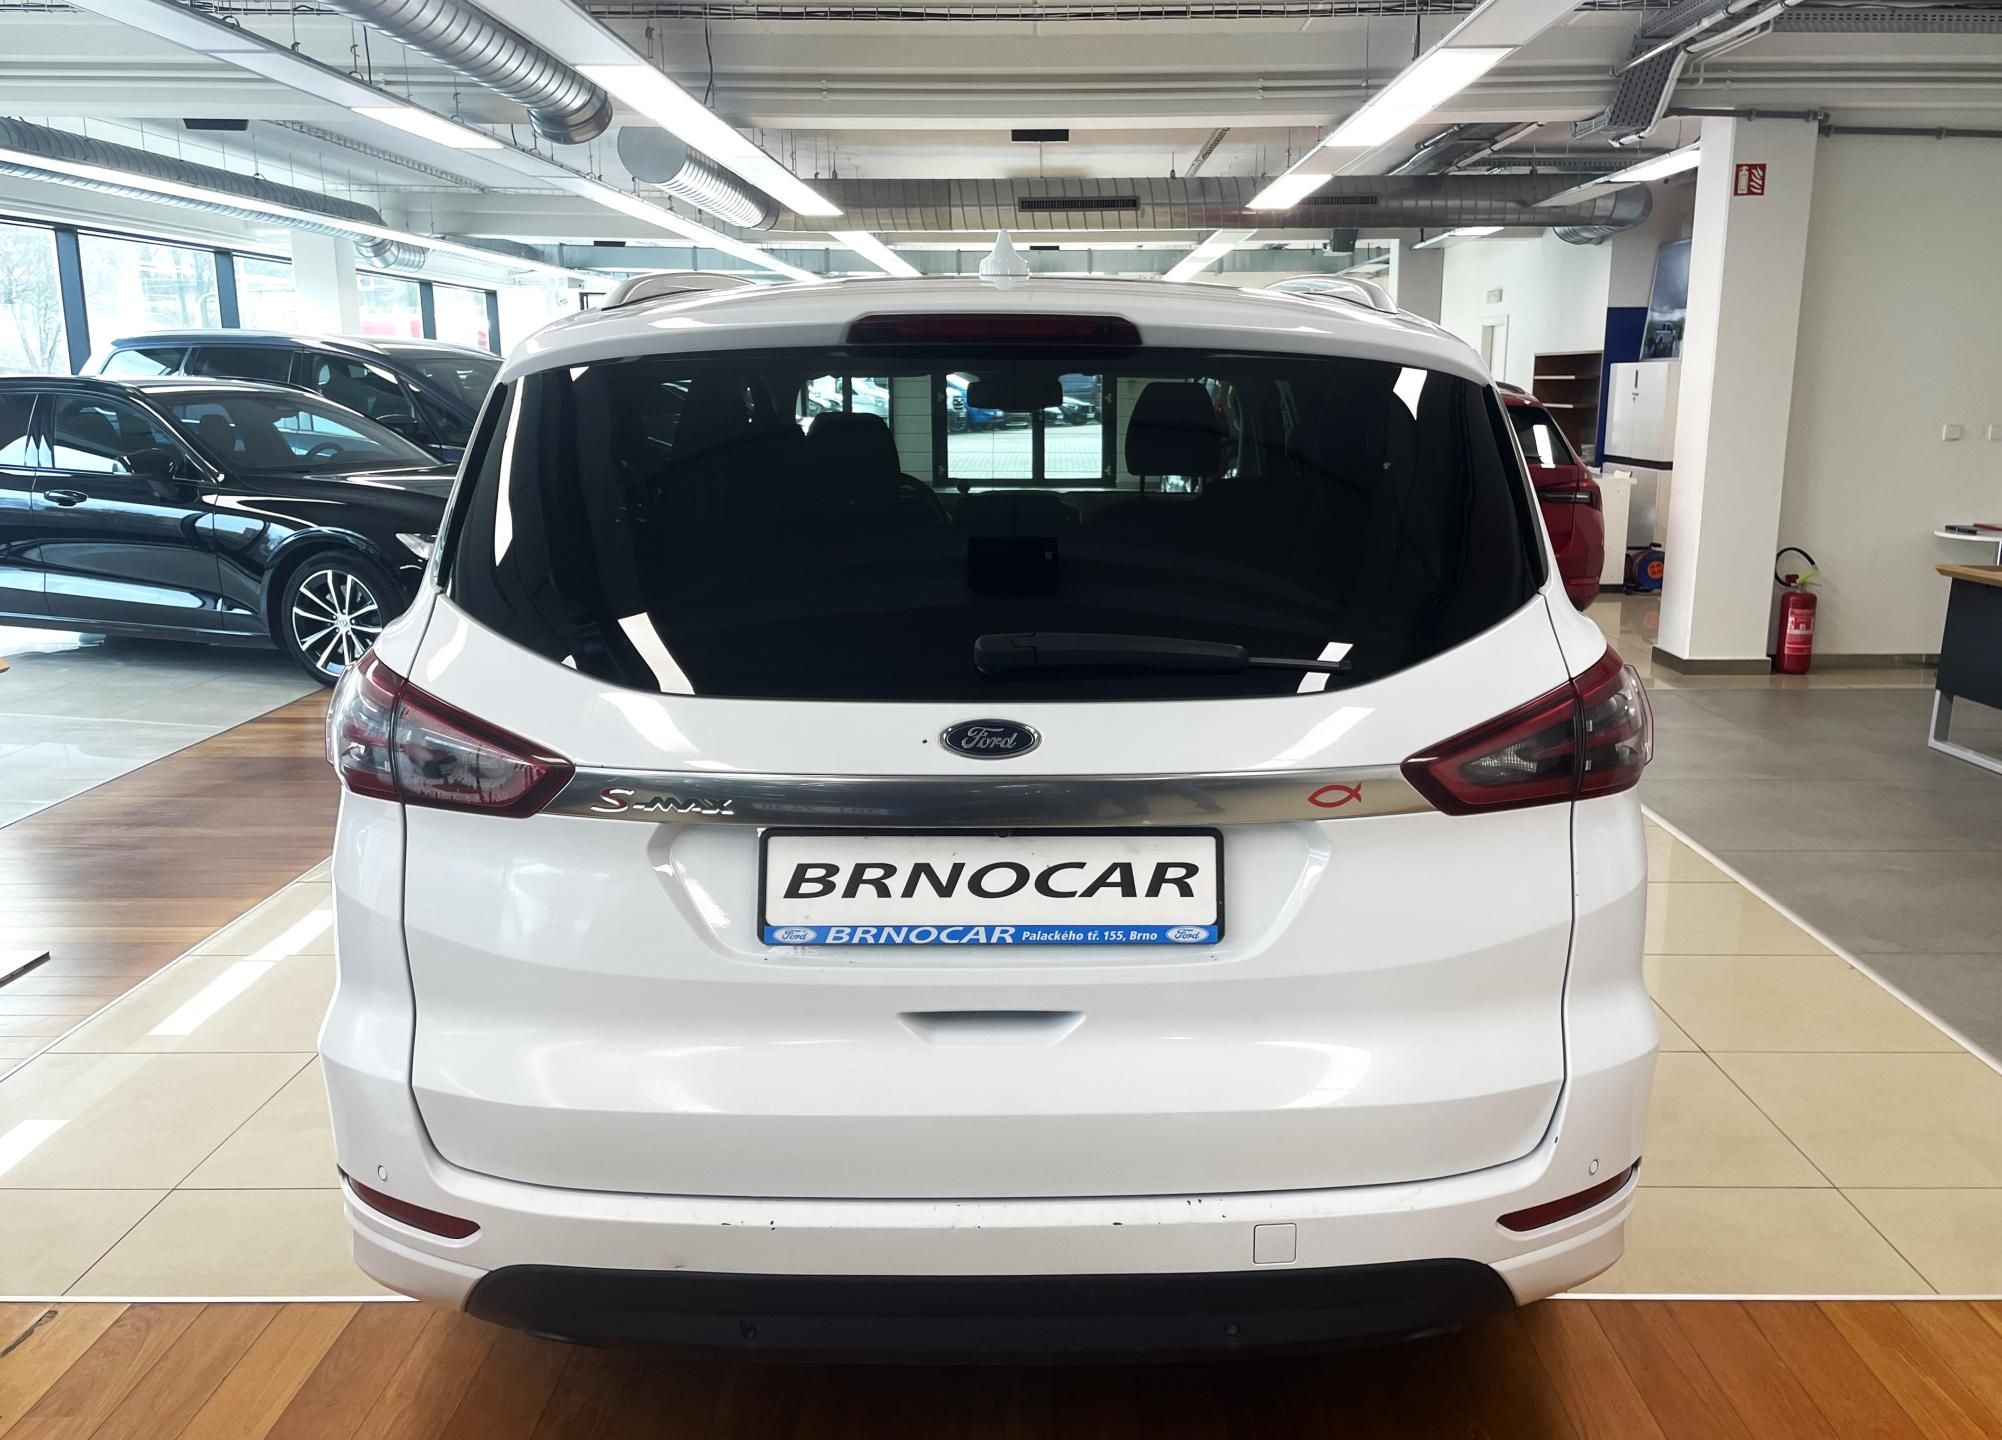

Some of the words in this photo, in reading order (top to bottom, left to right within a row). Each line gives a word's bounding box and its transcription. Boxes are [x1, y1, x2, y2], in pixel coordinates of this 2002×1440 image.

[962, 726, 1018, 748] Ford
[783, 862, 1200, 899] BRNOCAR
[781, 928, 808, 941] Ford
[825, 927, 1015, 943] BRNOCAR
[1021, 930, 1083, 941] Palackého
[1087, 929, 1100, 941] tř.
[1103, 931, 1126, 943] 155,
[1129, 931, 1158, 941] Brno
[1174, 927, 1201, 940] Ford
